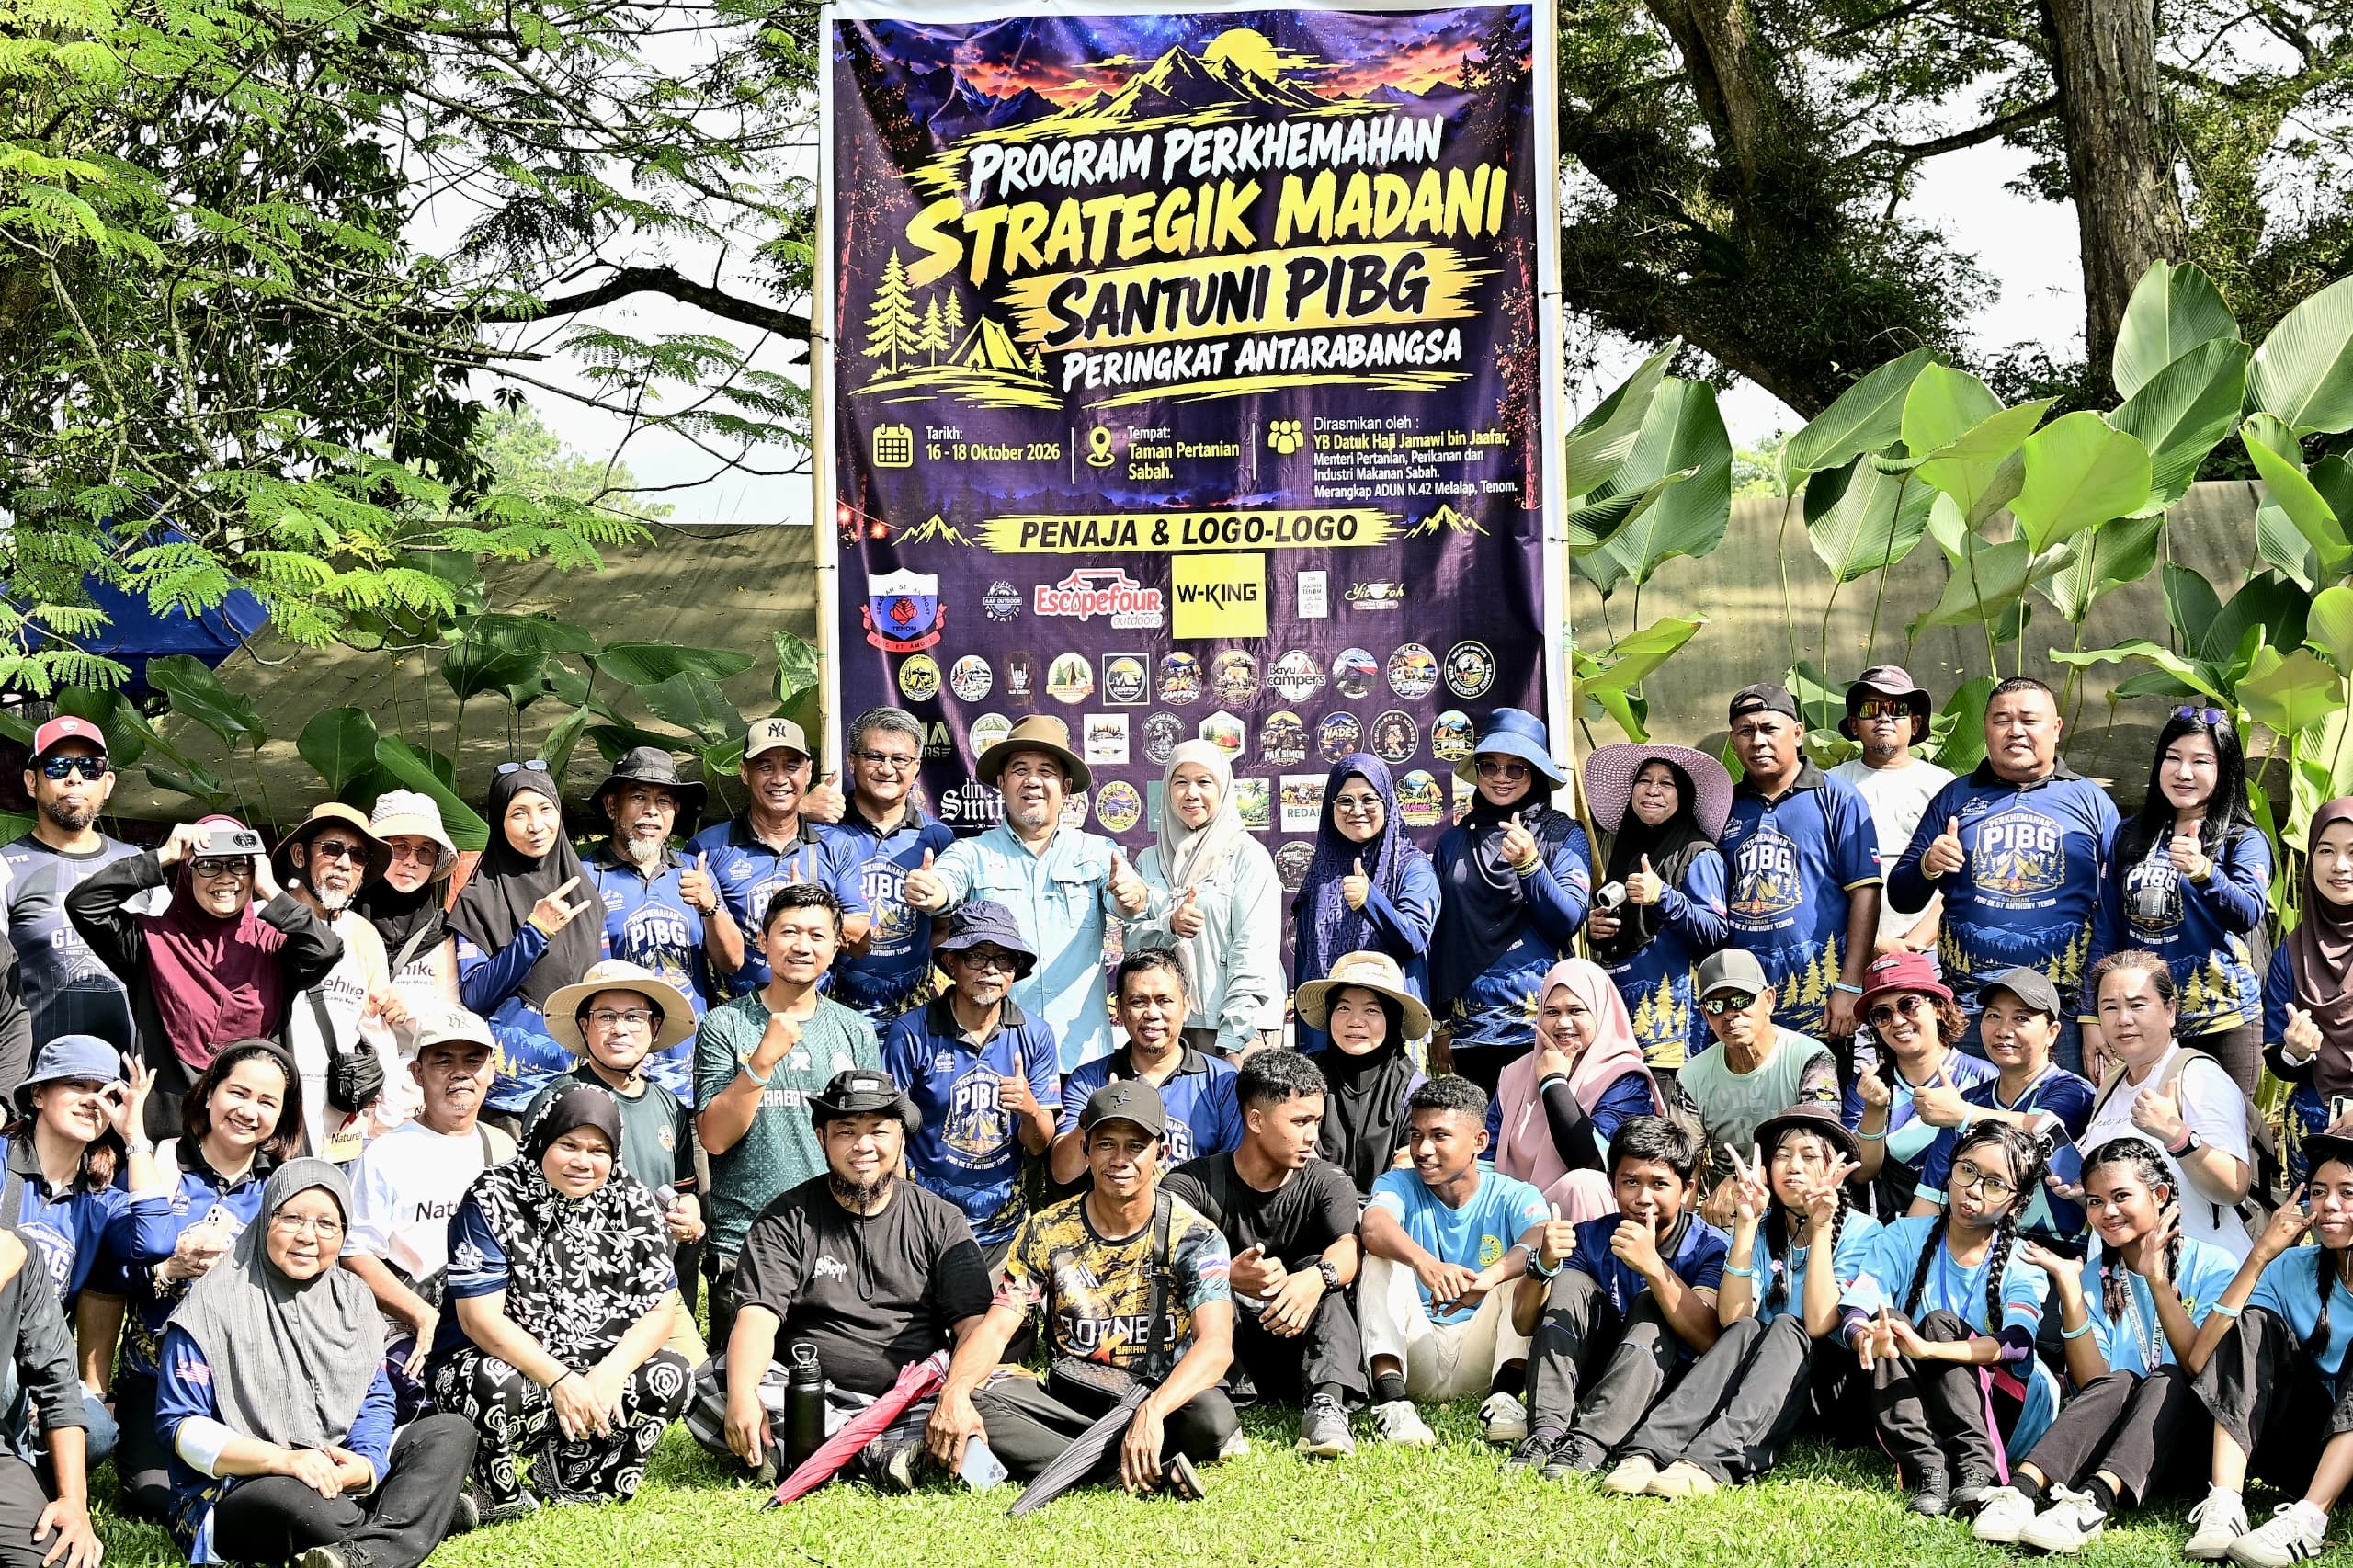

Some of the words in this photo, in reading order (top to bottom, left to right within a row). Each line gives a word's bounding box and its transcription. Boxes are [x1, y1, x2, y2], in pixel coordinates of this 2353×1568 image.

[969, 133, 1153, 204] PROGRAM
[1162, 112, 1444, 184] PERKHEMAHAN
[905, 177, 1263, 290] STRATEGIK
[1273, 162, 1507, 248] MADANI
[1043, 265, 1271, 347] SANTUNI
[1286, 251, 1430, 321] PIBG
[1063, 342, 1230, 393] PERINGKAT
[1234, 327, 1462, 375] ANTARABANGSA
[1313, 416, 1382, 431] Dirasmikan
[1385, 416, 1412, 430] oleh
[926, 426, 963, 440] Tarikh:
[1127, 426, 1171, 442] Tempat:
[1313, 435, 1330, 449] YB
[1334, 433, 1370, 449] Datuk
[1372, 432, 1396, 451] Haji
[1399, 431, 1444, 448] Jamawi
[1448, 430, 1467, 446] bin
[1470, 428, 1510, 447] Jaafar,
[926, 443, 942, 460] 16
[953, 443, 967, 460] 18
[971, 443, 1025, 460] Oktober
[1027, 443, 1061, 460] 2026
[1129, 444, 1173, 460] Taman
[1176, 440, 1241, 459] Pertanian
[1313, 452, 1354, 466] Menteri
[1357, 450, 1408, 466] Pertanian,
[1411, 449, 1462, 464] Perikanan
[1464, 448, 1484, 461] dan
[1129, 461, 1173, 480] Sabah.
[1313, 468, 1354, 482] Industri
[1357, 467, 1404, 481] Makanan
[1405, 466, 1440, 480] Sabah.
[1314, 483, 1372, 501] Merangkap
[1375, 483, 1405, 496] ADUN
[1408, 482, 1433, 496] N.42
[1435, 481, 1478, 498] Melalap,
[1481, 480, 1518, 494] Tenom.
[1019, 518, 1139, 548] PENAJA
[1151, 518, 1171, 545] &
[1182, 514, 1358, 545] LOGO-LOGO
[1177, 583, 1257, 610] W-KING
[1113, 613, 1161, 626] outdoors
[1268, 664, 1295, 675] Bayu
[1267, 675, 1325, 689] campers
[1324, 727, 1359, 741] HADES
[1988, 813, 2052, 828] PERKHEMAHAN
[1984, 824, 2057, 854] PIBG
[860, 864, 906, 878] ERKHEMAHAN
[2005, 901, 2035, 911] ANTHONY
[51, 928, 86, 949] GL
[630, 920, 688, 953] PIBG
[958, 1072, 1001, 1090] PERKHEMAHA
